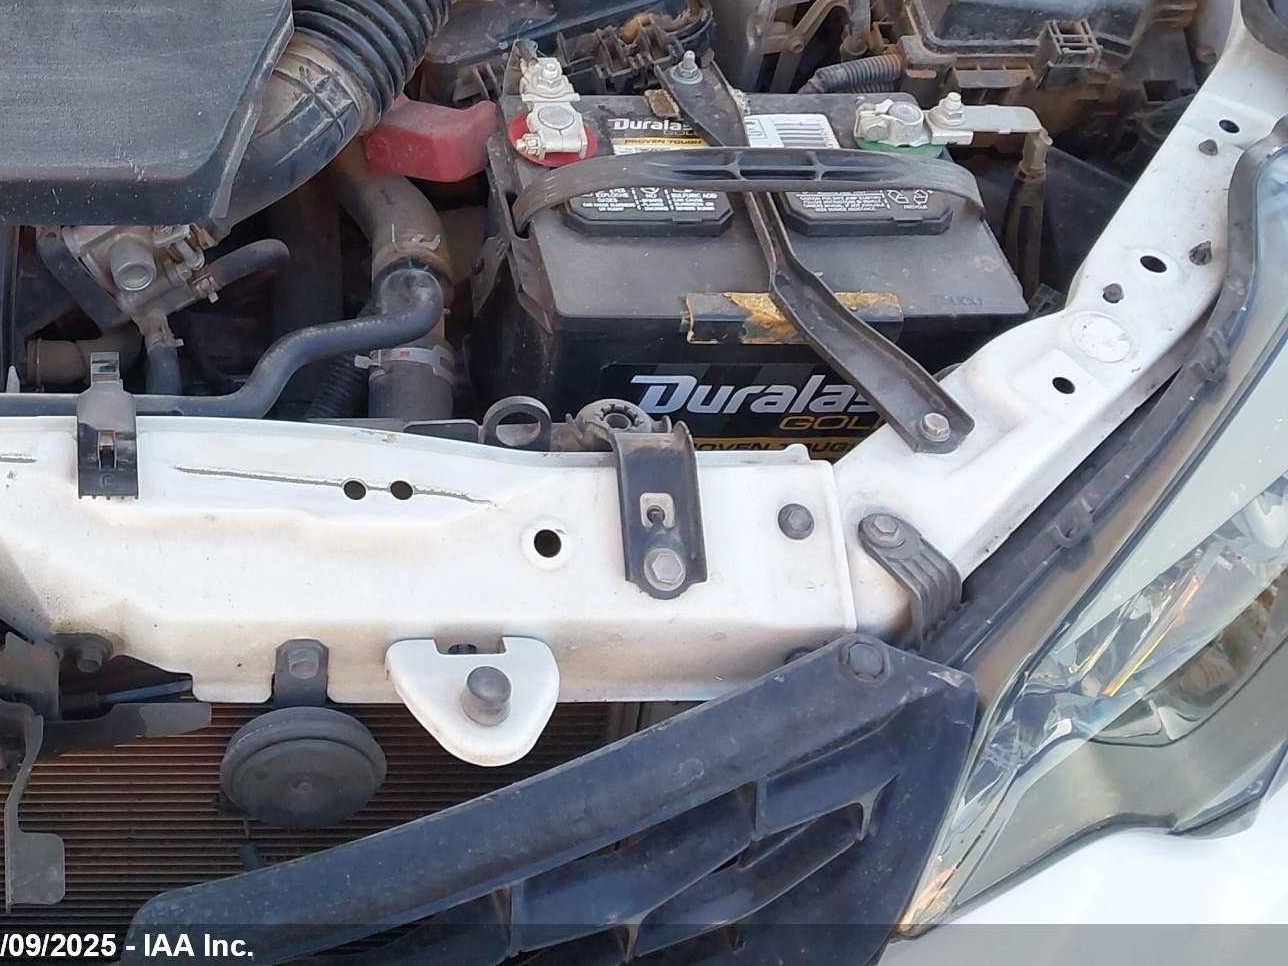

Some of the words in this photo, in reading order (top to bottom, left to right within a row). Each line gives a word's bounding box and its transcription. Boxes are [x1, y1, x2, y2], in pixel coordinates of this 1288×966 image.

[608, 118, 693, 131] Duralas
[630, 374, 878, 414] Duralas
[779, 415, 882, 431] GOL
